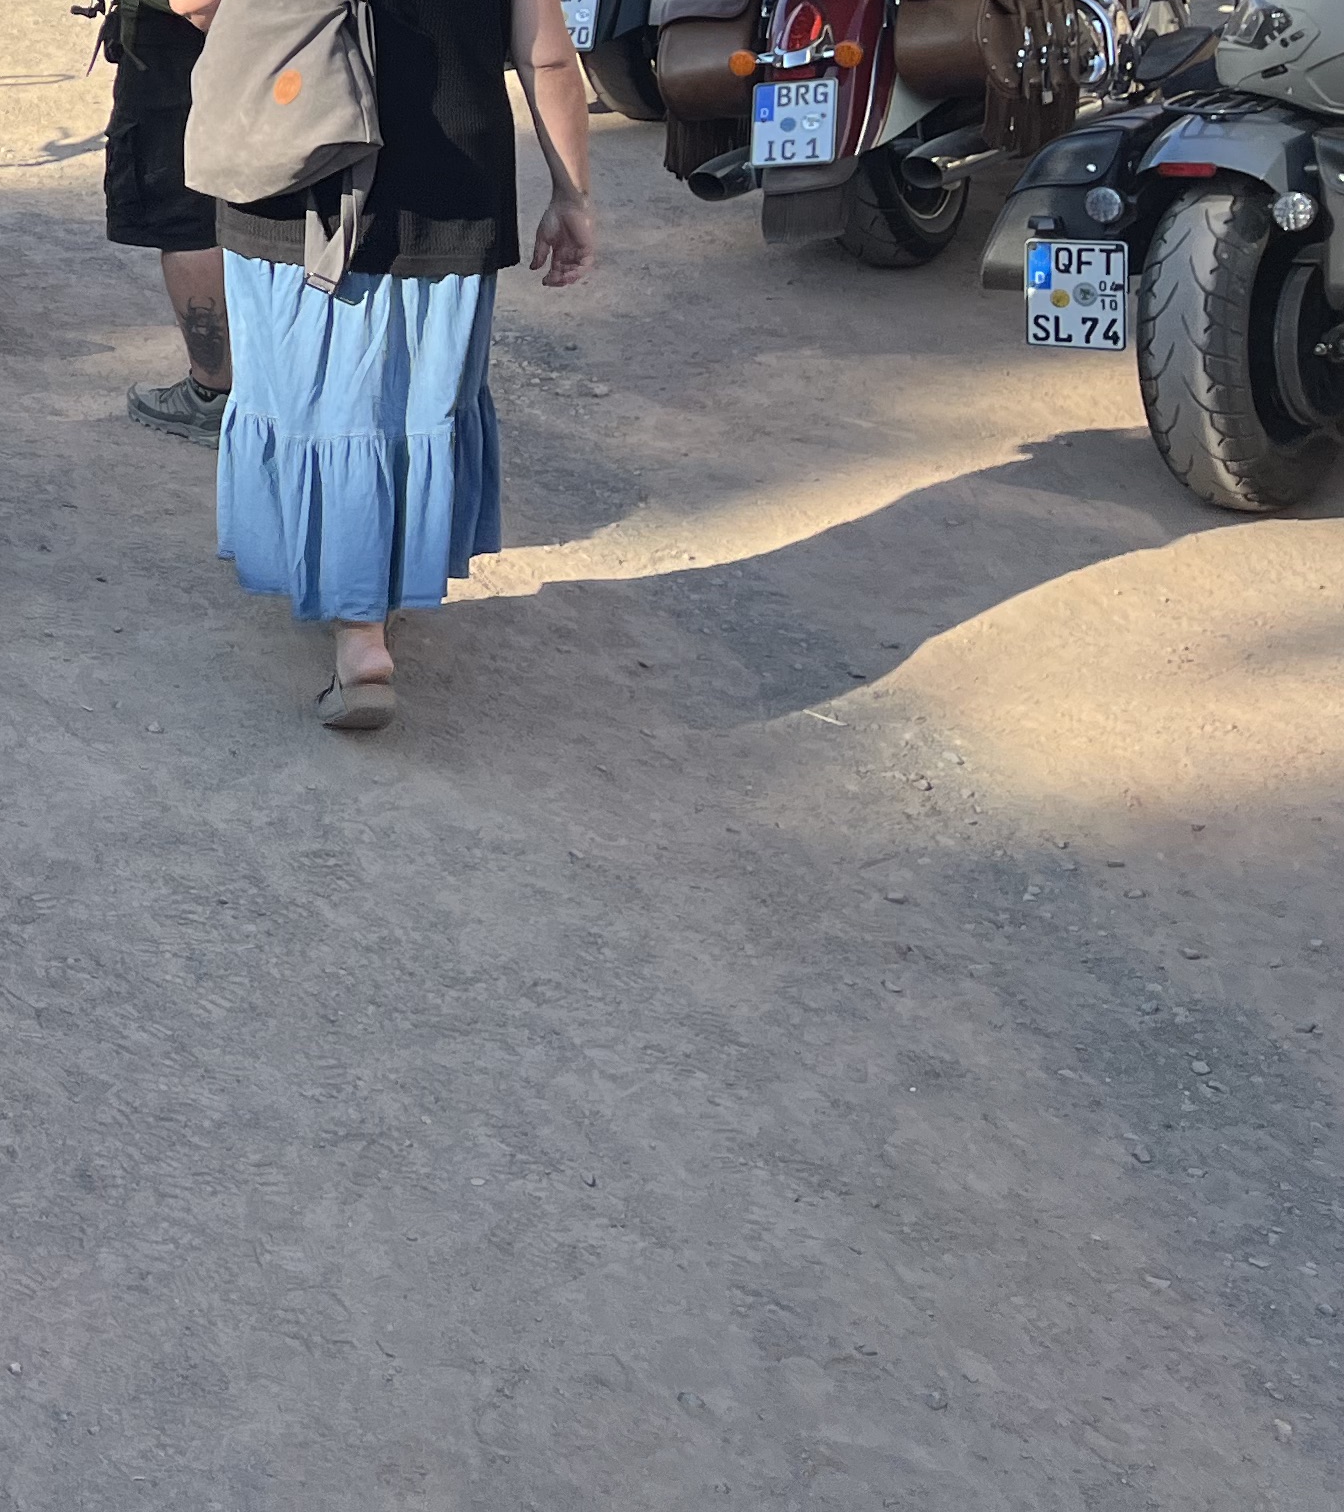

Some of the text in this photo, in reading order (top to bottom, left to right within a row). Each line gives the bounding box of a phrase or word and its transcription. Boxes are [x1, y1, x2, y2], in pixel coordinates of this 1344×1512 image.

[776, 83, 829, 107] BRG
[759, 107, 770, 118] D
[763, 137, 820, 162] IC 1
[1054, 246, 1123, 276] QFT
[1034, 270, 1047, 285] D
[1100, 298, 1119, 311] 10
[1032, 314, 1121, 347] SL 74
